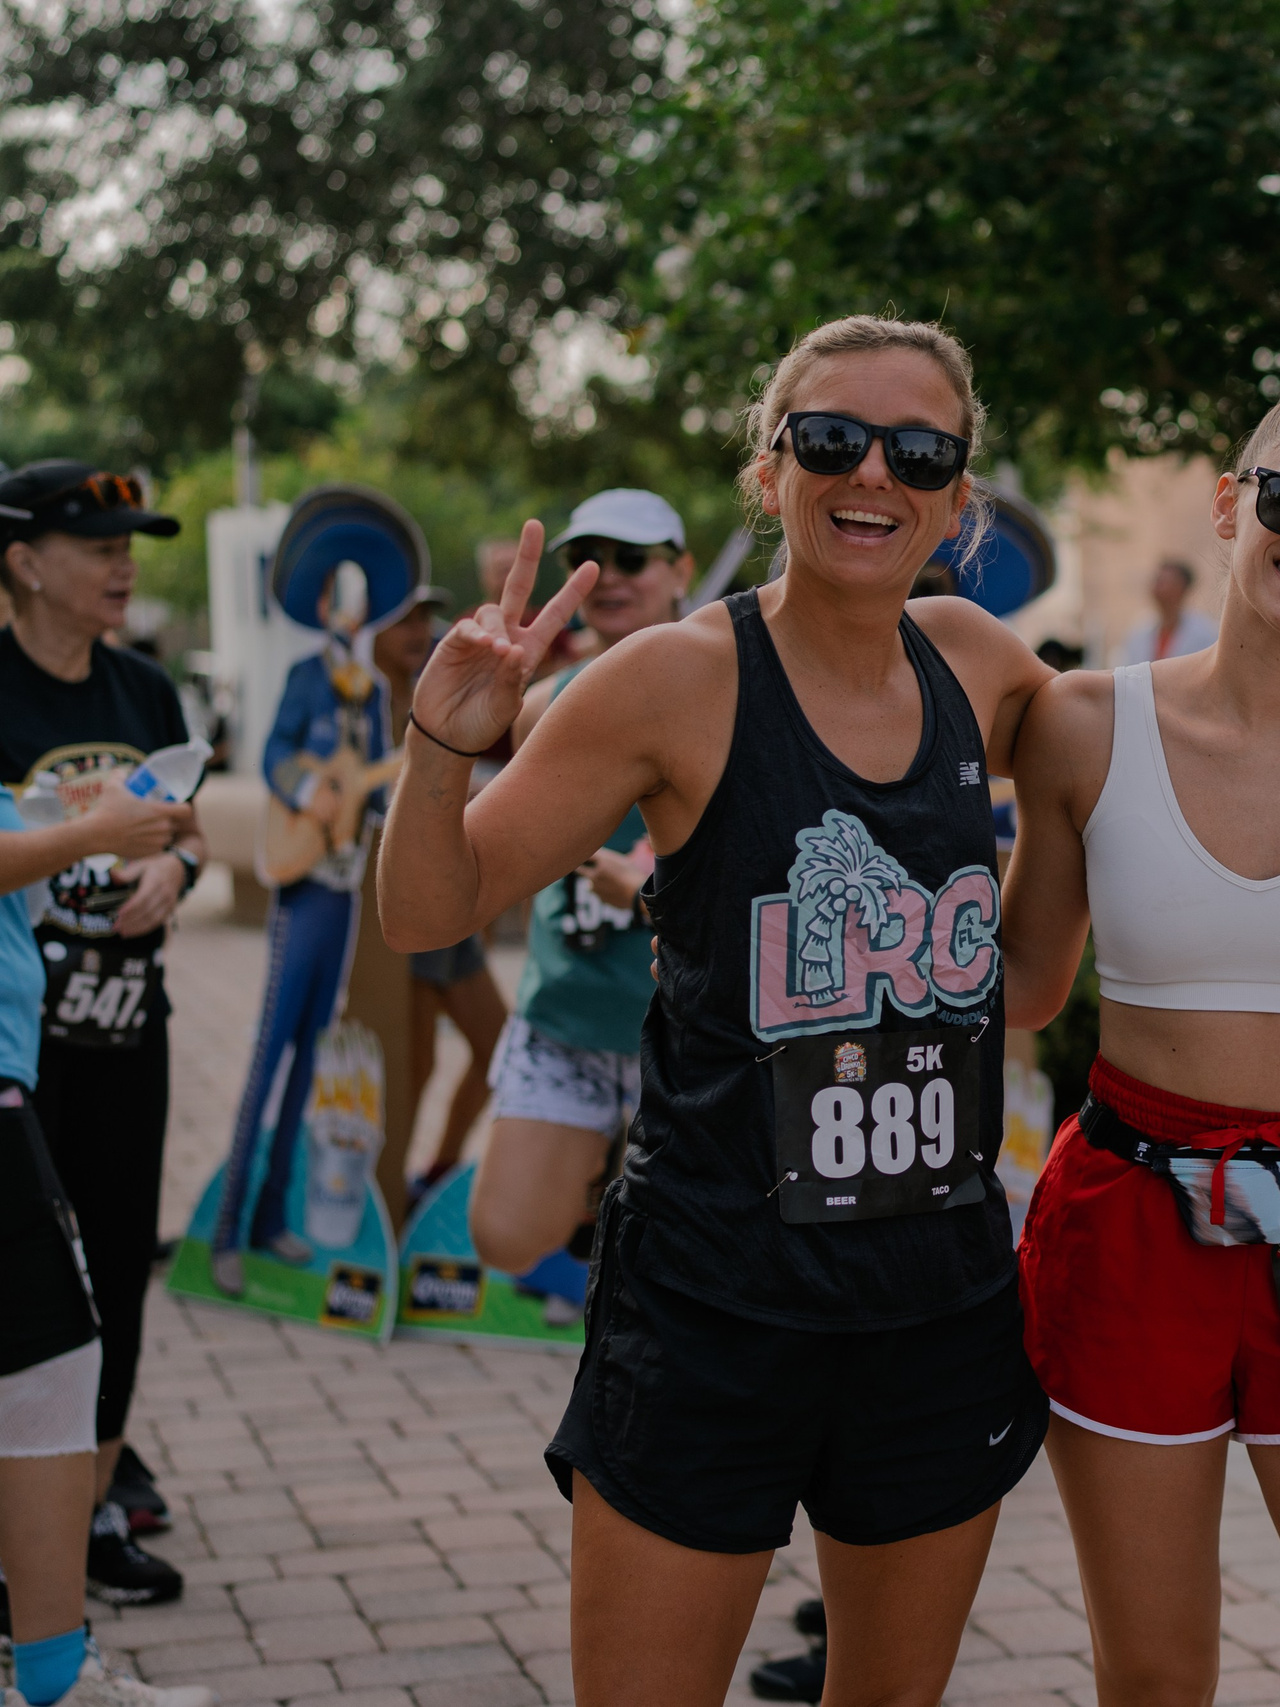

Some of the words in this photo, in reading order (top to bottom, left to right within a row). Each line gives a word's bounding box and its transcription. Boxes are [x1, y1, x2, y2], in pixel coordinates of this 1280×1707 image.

[751, 866, 1000, 1040] LRC
[56, 970, 146, 1030] 547
[906, 1043, 943, 1073] 5K
[811, 1077, 955, 1179] 889
[826, 1196, 857, 1206] BEER
[931, 1185, 950, 1196] TACO
